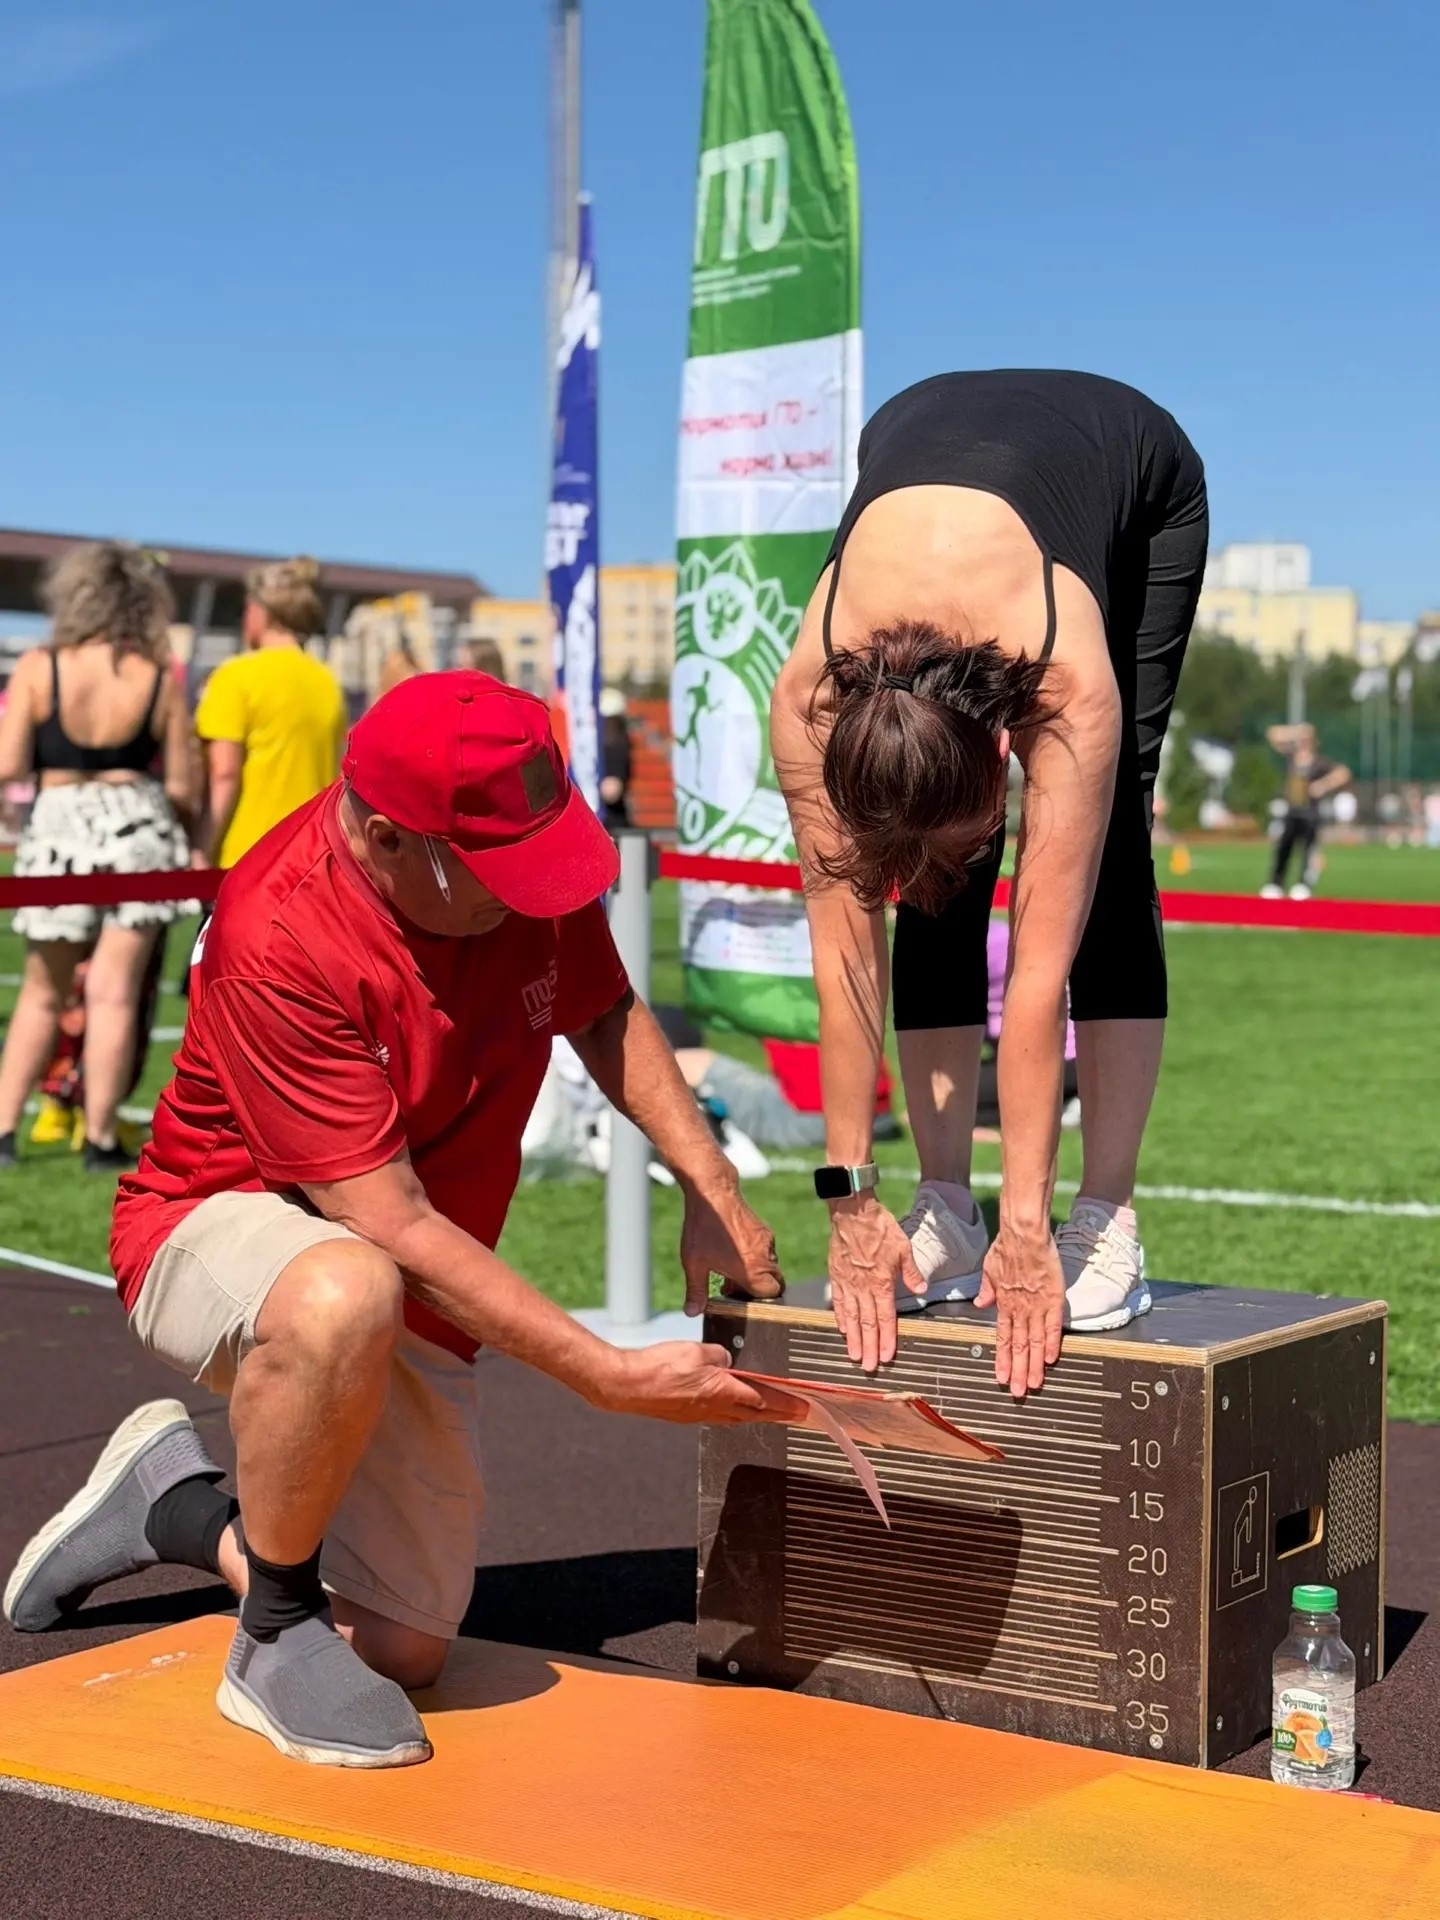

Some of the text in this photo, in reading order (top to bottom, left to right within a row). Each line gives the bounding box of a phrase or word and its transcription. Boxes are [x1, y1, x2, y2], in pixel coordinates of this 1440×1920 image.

[1130, 1381, 1150, 1410] 5
[1129, 1438, 1161, 1468] 10
[1128, 1490, 1165, 1522] 15
[1128, 1544, 1167, 1576] 20
[1127, 1595, 1171, 1628] 25
[1126, 1649, 1166, 1681] 30
[1126, 1700, 1170, 1733] 35
